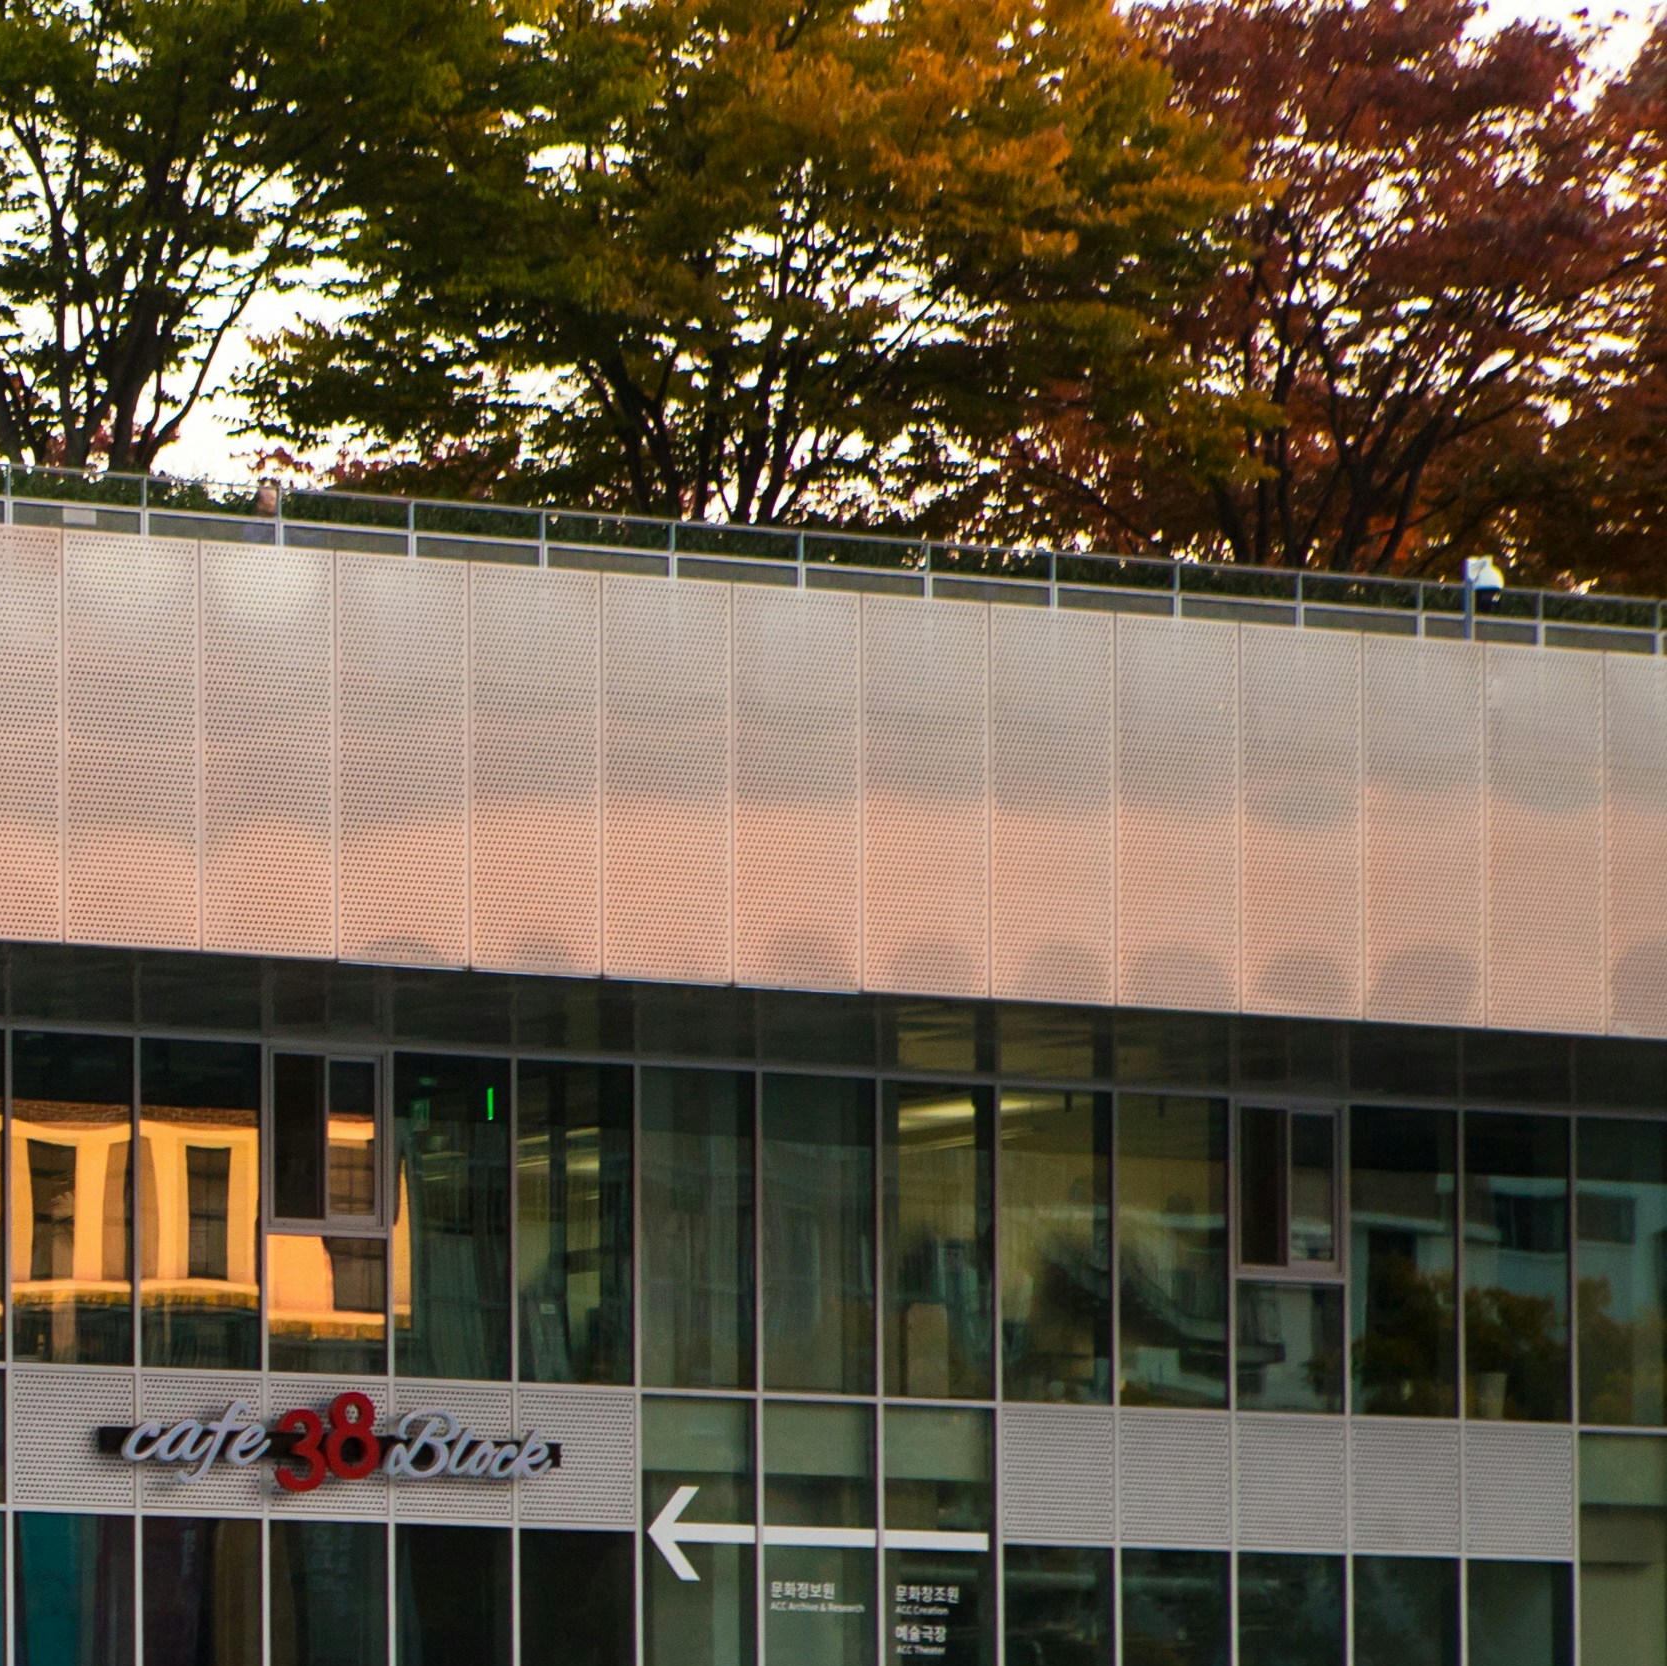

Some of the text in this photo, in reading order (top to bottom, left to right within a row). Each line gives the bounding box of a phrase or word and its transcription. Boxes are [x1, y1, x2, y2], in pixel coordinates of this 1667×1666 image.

[121, 1391, 553, 1492] cafe 38 Block
[771, 1581, 835, 1599] 문화정보원
[895, 1585, 960, 1604] 문화창조원
[770, 1601, 787, 1611] ACC
[788, 1601, 819, 1612] Archive
[828, 1602, 866, 1613] Research
[895, 1605, 949, 1616] ACC Creation
[895, 1624, 947, 1643] 예술극장
[896, 1645, 946, 1656] ACC Theater
